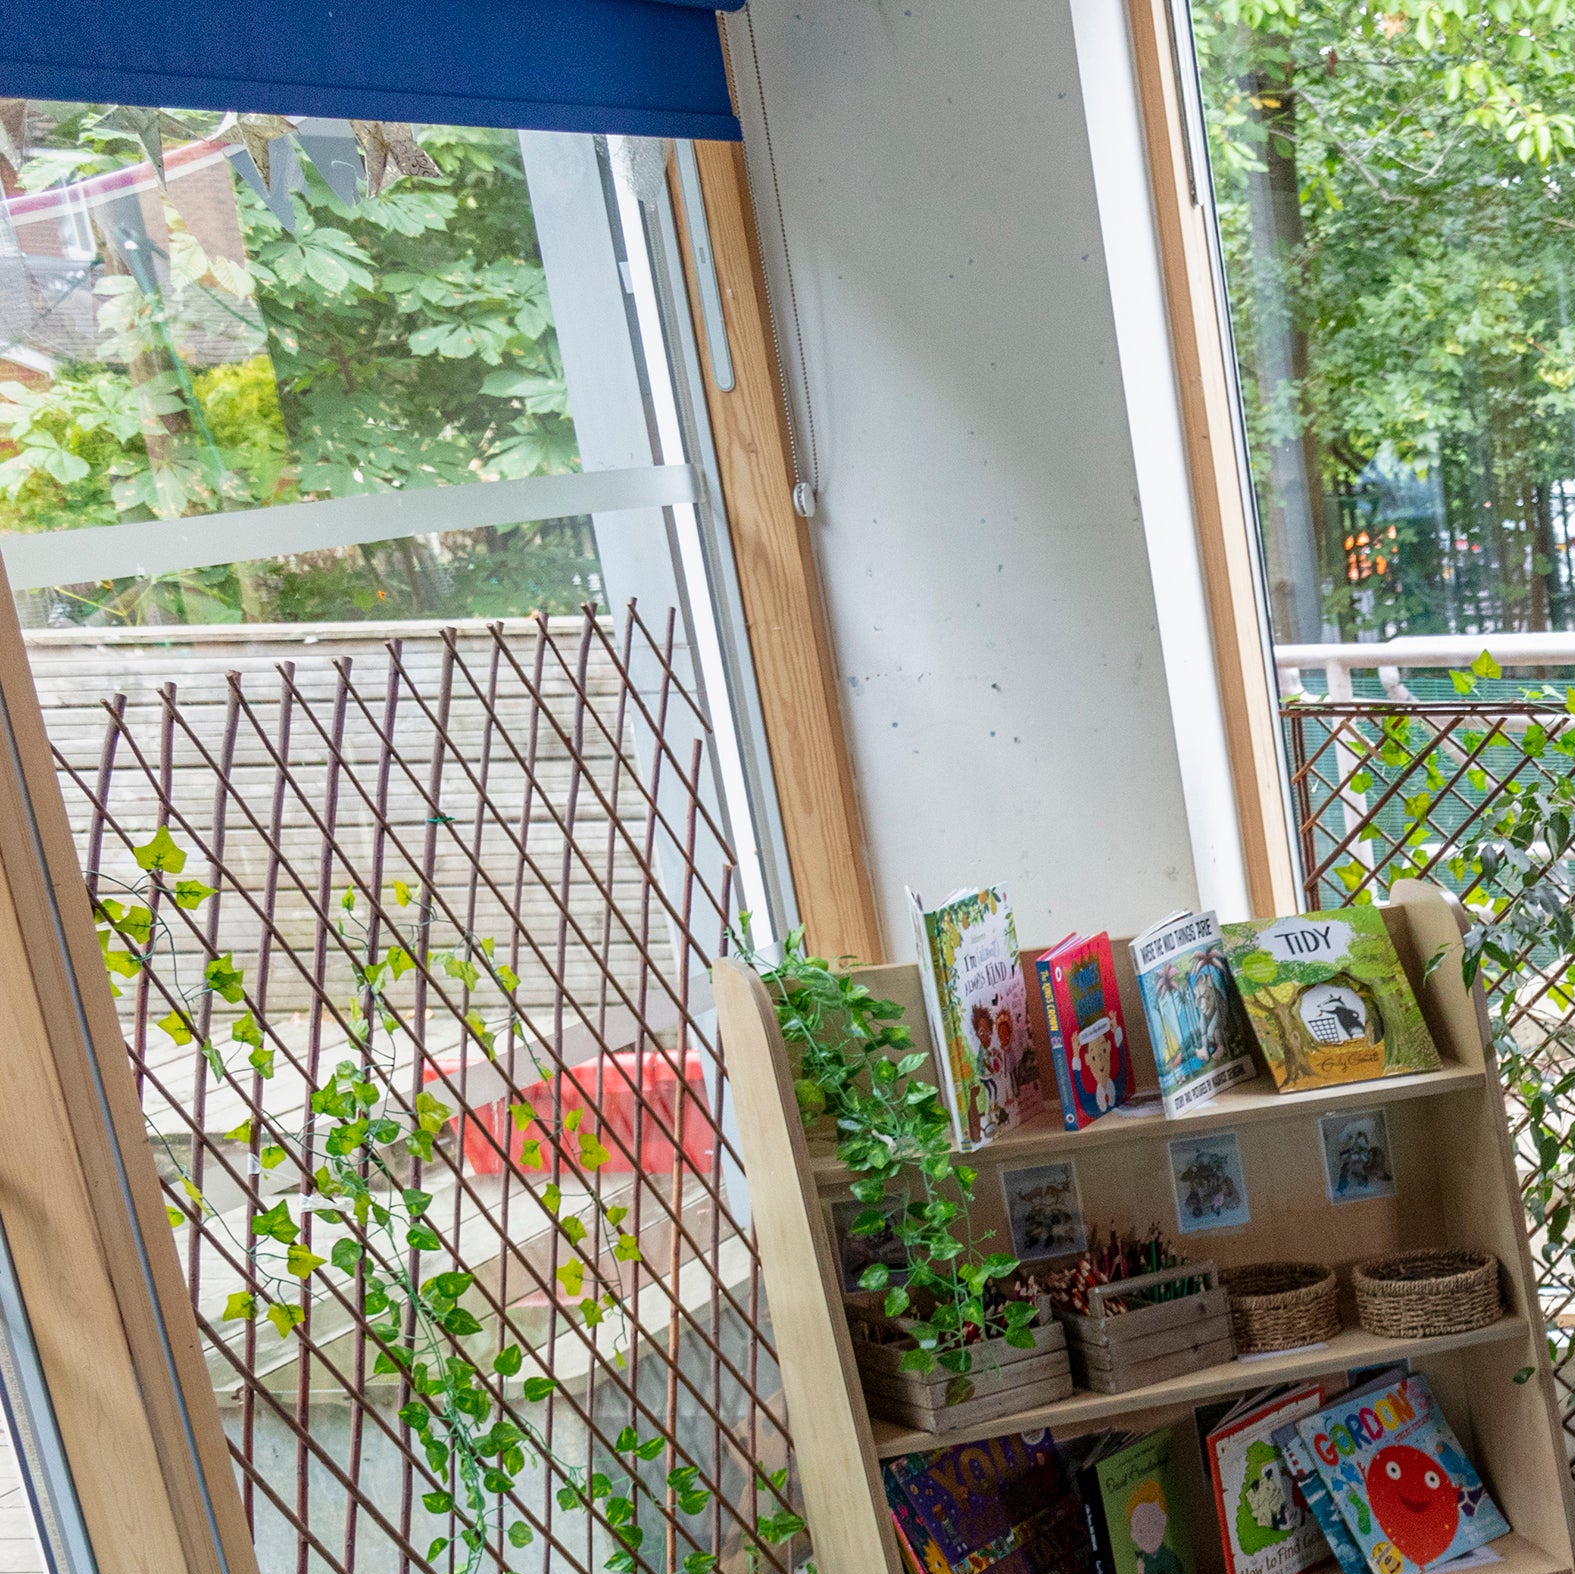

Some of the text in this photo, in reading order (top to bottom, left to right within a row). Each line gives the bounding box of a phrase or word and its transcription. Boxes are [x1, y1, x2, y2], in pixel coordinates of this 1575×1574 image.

[1195, 918, 1212, 939] ARE
[1274, 926, 1332, 956] TIDY
[1314, 1380, 1435, 1467] GORDON'S
[1265, 1555, 1278, 1571] to
[1278, 1540, 1300, 1566] Find
